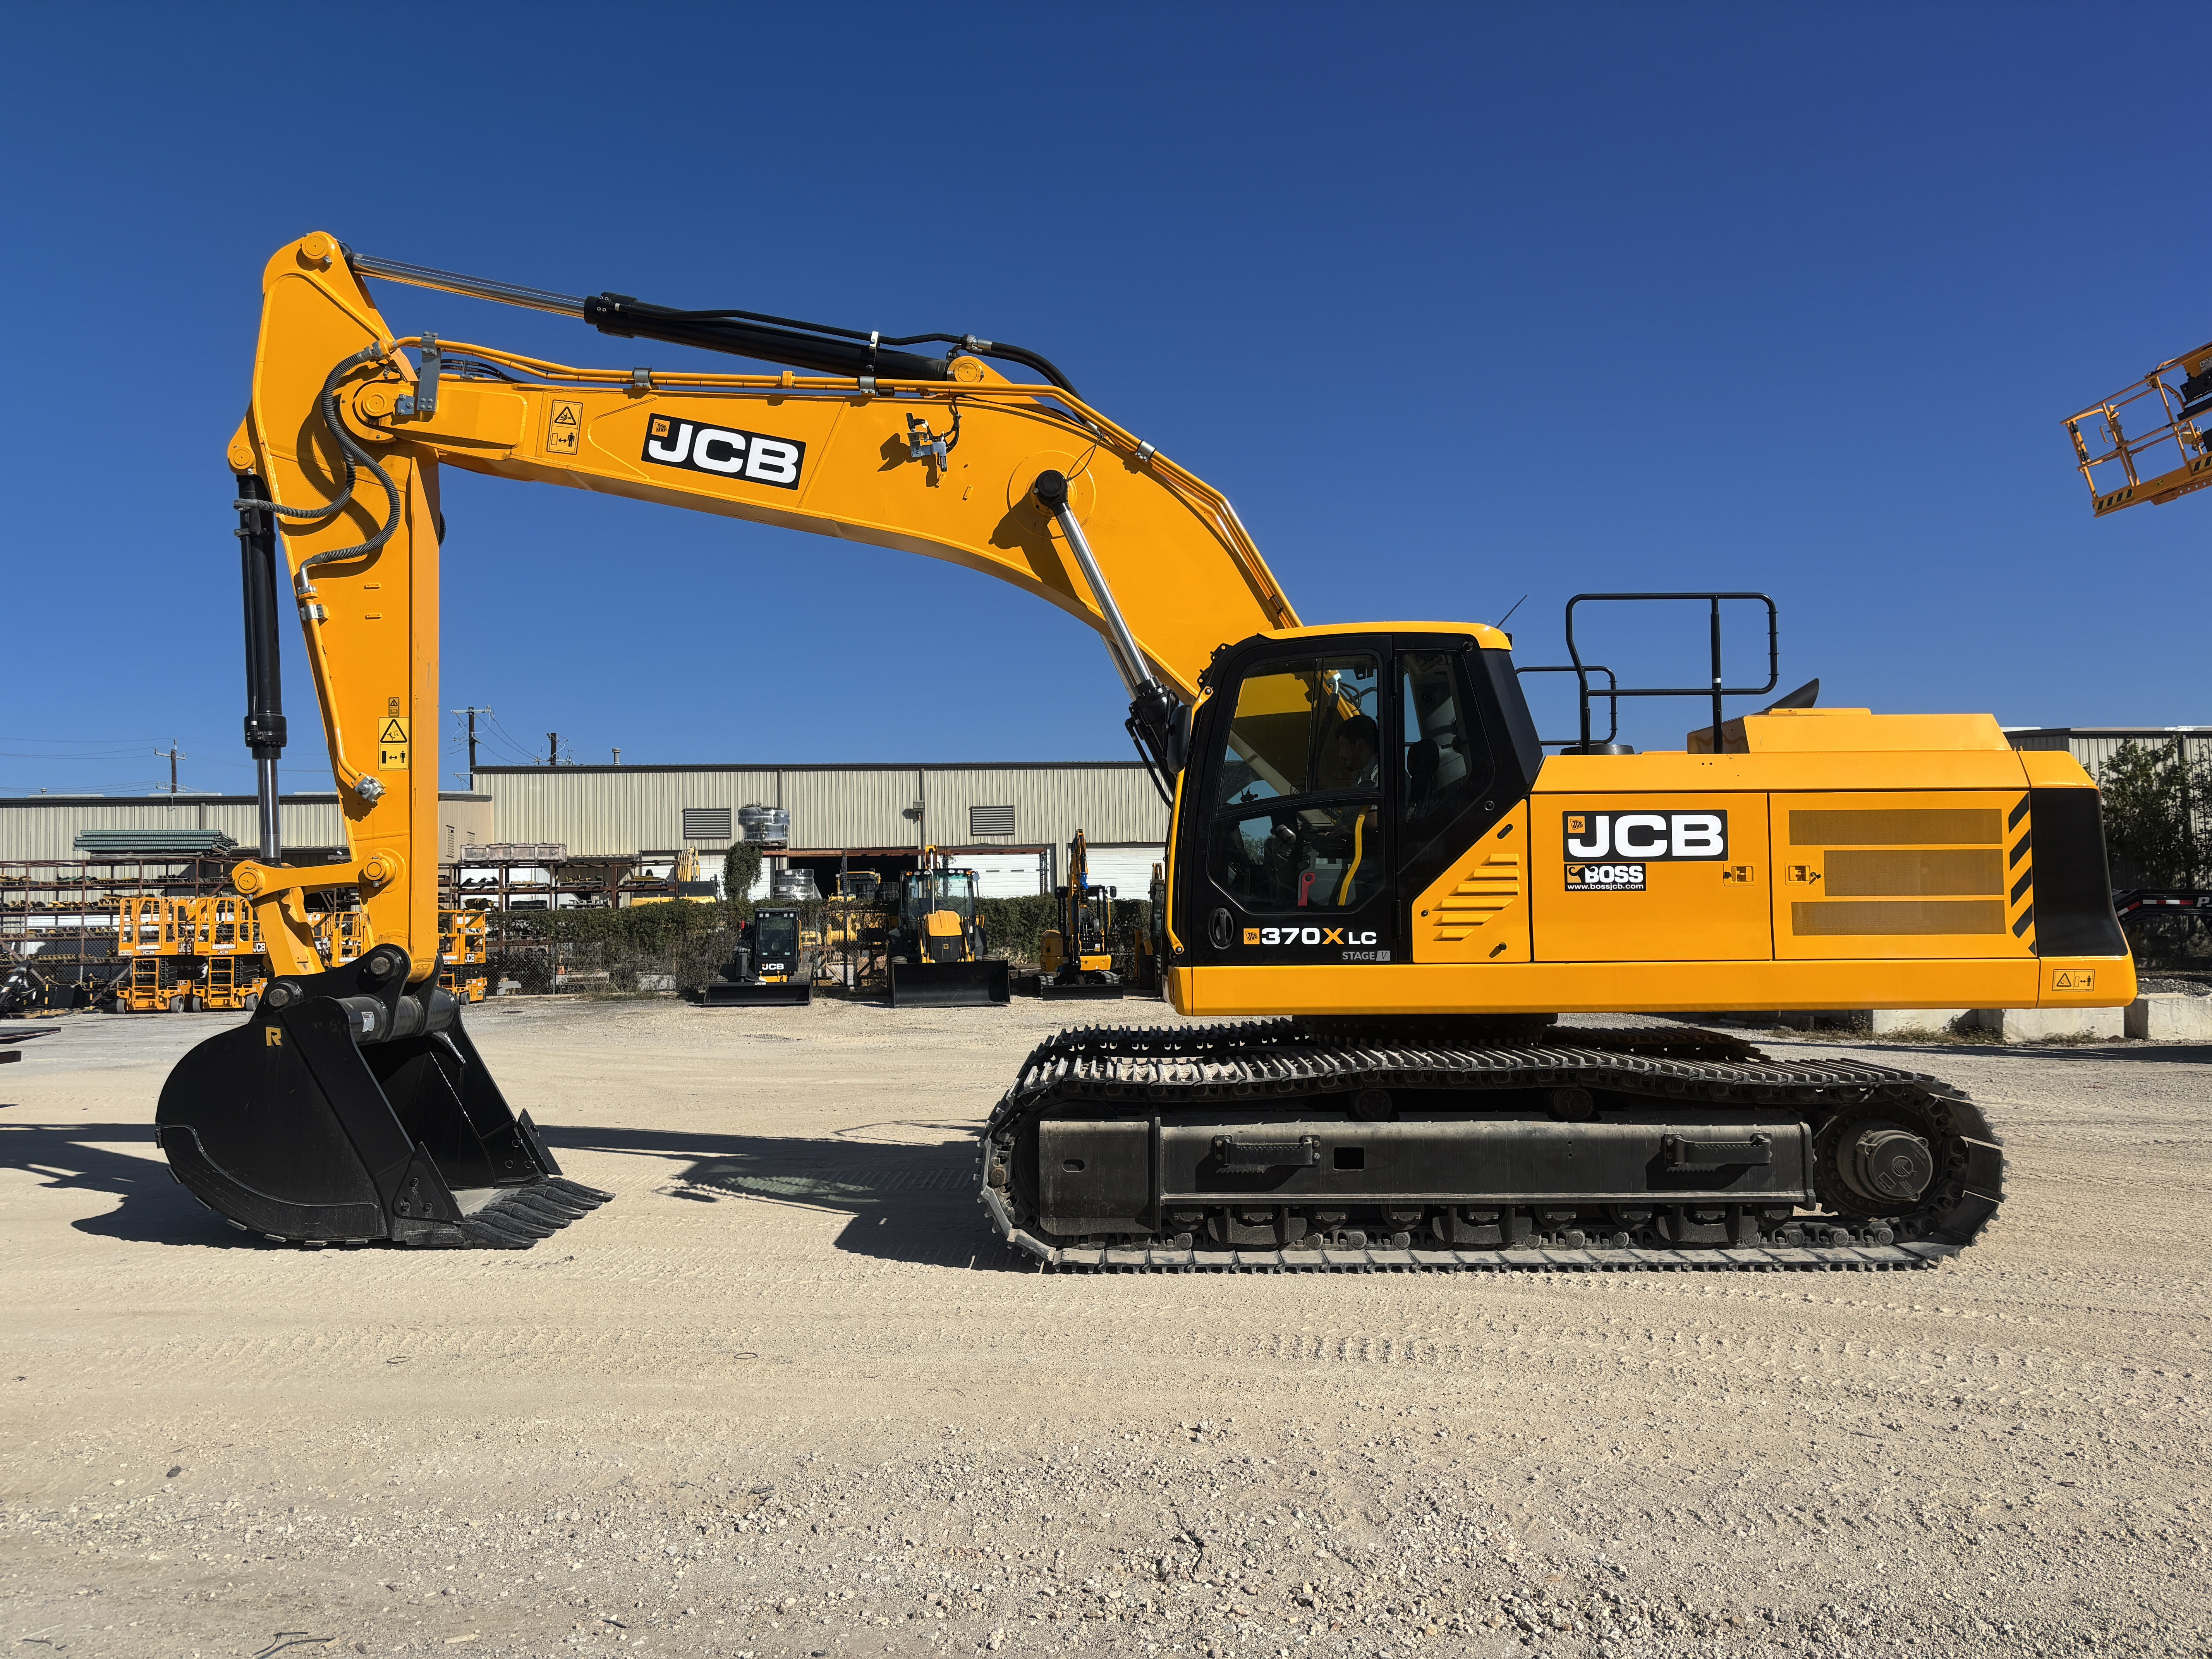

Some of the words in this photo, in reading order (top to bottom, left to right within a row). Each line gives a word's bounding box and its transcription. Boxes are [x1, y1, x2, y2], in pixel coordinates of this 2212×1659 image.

[648, 424, 799, 483] JCB
[1568, 815, 1724, 857] JCB
[1585, 866, 1644, 883] BOSS
[1261, 928, 1345, 945] 370X
[1348, 932, 1377, 945] LC
[253, 943, 266, 952] JCB
[1342, 951, 1375, 960] STAGE
[1381, 951, 1388, 960] V
[465, 953, 475, 963] JCB
[266, 1026, 282, 1046] R
